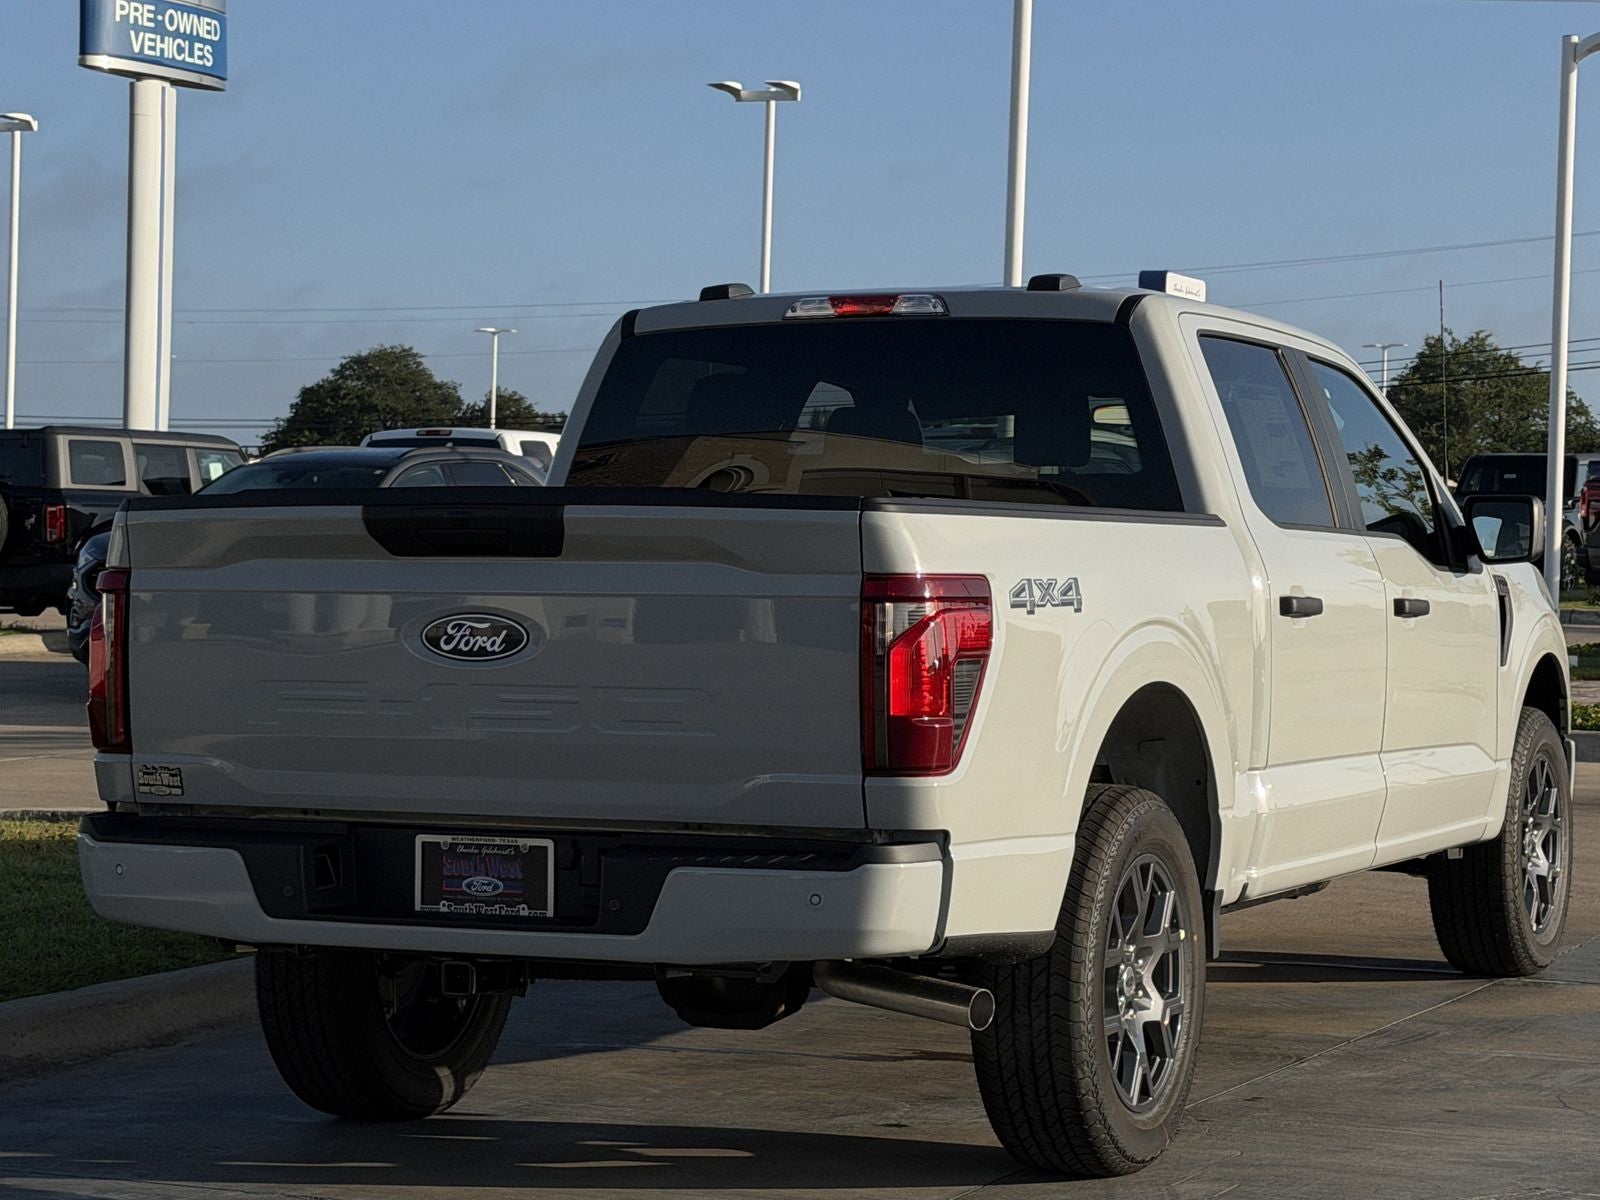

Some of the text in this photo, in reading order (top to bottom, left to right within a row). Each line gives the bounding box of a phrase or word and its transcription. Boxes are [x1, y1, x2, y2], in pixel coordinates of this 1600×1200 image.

[115, 0, 221, 41] PRE-OWNED
[129, 30, 214, 67] VEHICLES
[440, 620, 508, 652] Ford
[499, 837, 519, 845] TEXAS
[471, 880, 495, 892] Ford
